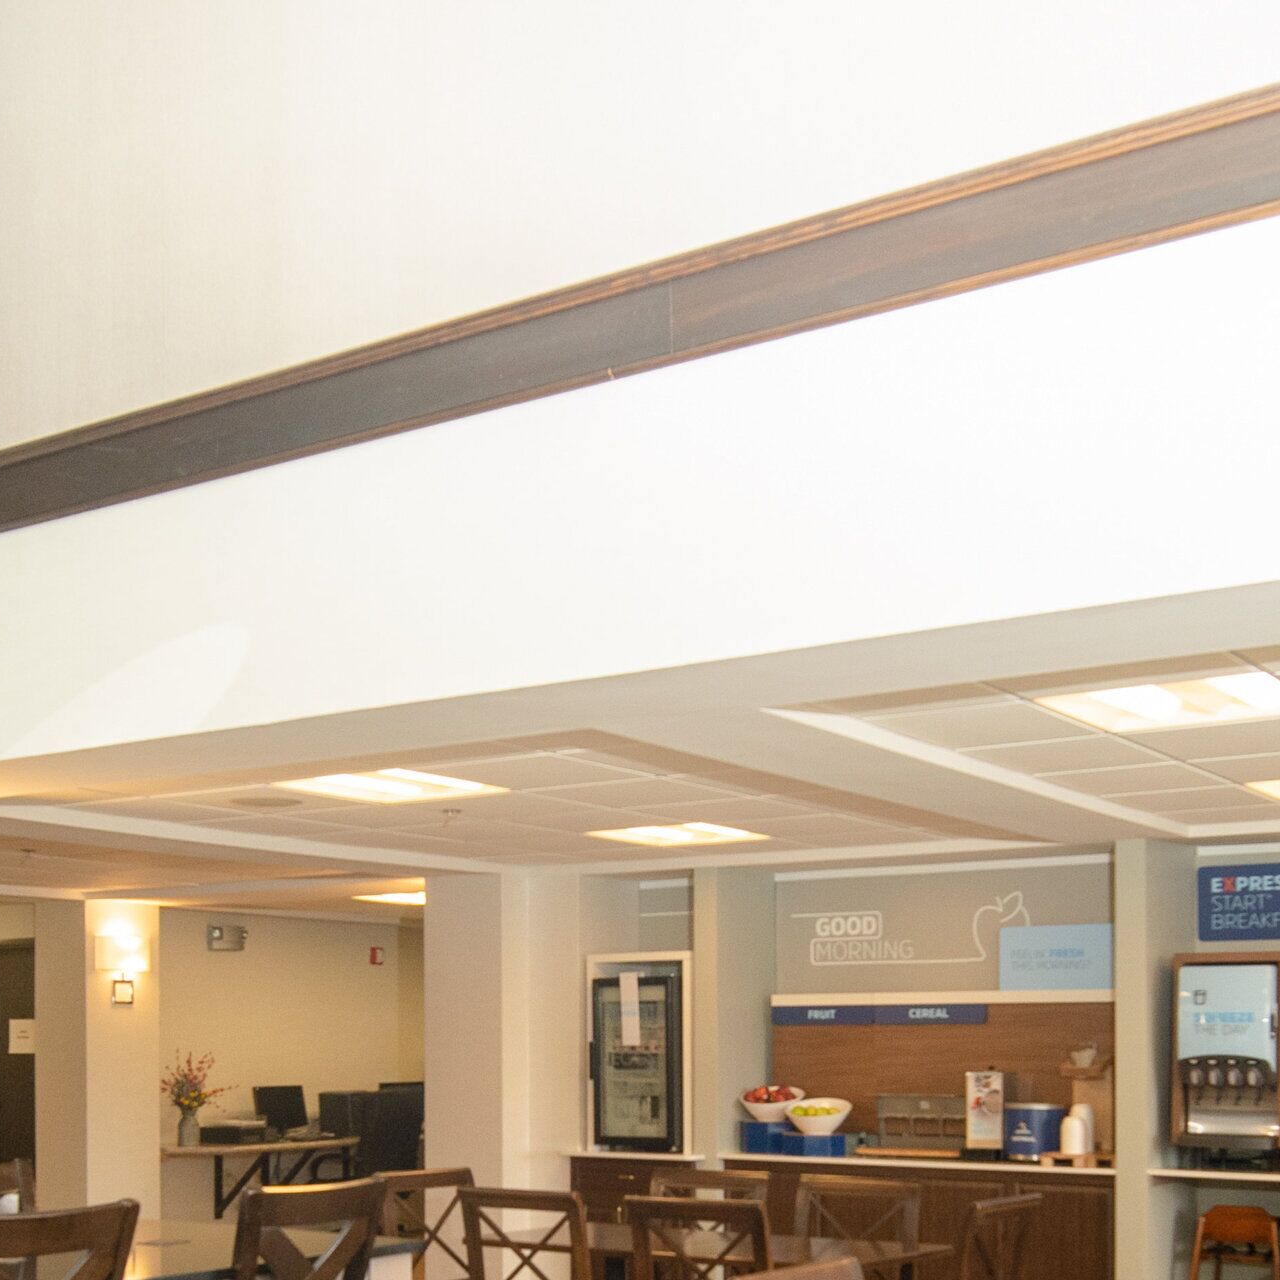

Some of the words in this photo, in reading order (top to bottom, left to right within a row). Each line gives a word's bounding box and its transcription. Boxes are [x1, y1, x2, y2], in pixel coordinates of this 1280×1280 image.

[815, 916, 877, 936] GOOD
[815, 940, 914, 960] MORNING
[807, 1009, 836, 1020] FRUIT
[908, 1007, 950, 1019] CEREAL
